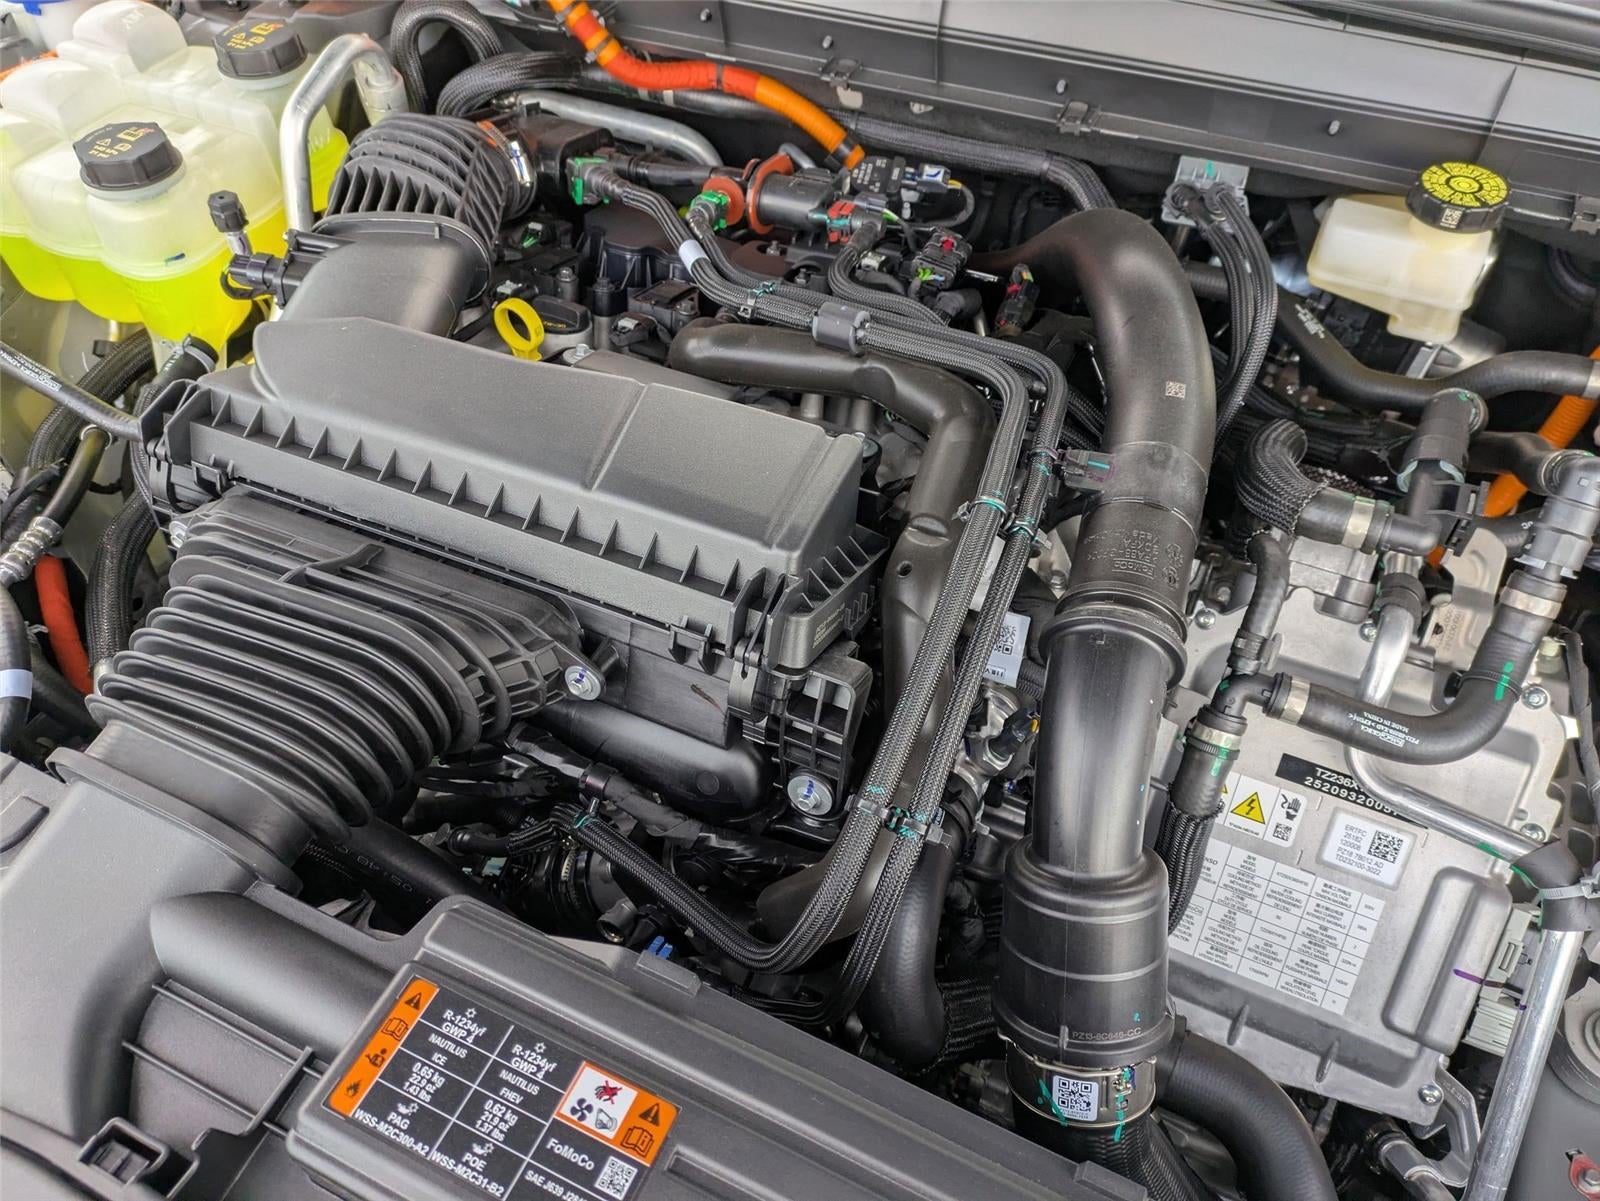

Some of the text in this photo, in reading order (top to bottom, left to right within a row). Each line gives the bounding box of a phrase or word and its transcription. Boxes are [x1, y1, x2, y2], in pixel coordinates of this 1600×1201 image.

[1362, 710, 1383, 722] CHINA
[1390, 721, 1409, 732] MADE
[1315, 766, 1365, 792] TZ236X
[1373, 861, 1384, 869] AD
[441, 1020, 475, 1044] GWP 4
[442, 1008, 486, 1038] R-1234yf
[427, 1032, 468, 1058] NAUTILUS
[430, 1052, 447, 1066] ICE
[510, 1043, 556, 1074] R-1234yf
[510, 1056, 545, 1079] GWP 4
[408, 1072, 436, 1093] 22.9 oz
[411, 1061, 446, 1088] 0.65 kg
[499, 1069, 540, 1095] NAUTILUS
[402, 1081, 432, 1102] 1.43 lbs
[498, 1086, 523, 1105] FHEV
[386, 1111, 410, 1130] PAG
[480, 1110, 510, 1132] 21.9 oz
[483, 1098, 519, 1126] 0.62 kg
[355, 1108, 429, 1156] WSS-M2C300-A2
[474, 1119, 506, 1142] 1.37 lbs
[461, 1152, 487, 1172] POE
[546, 1137, 596, 1171] FoMoCo
[431, 1151, 504, 1197] WSS-M2C31-B2
[525, 1170, 545, 1187] SAE
[543, 1181, 564, 1197] J639
